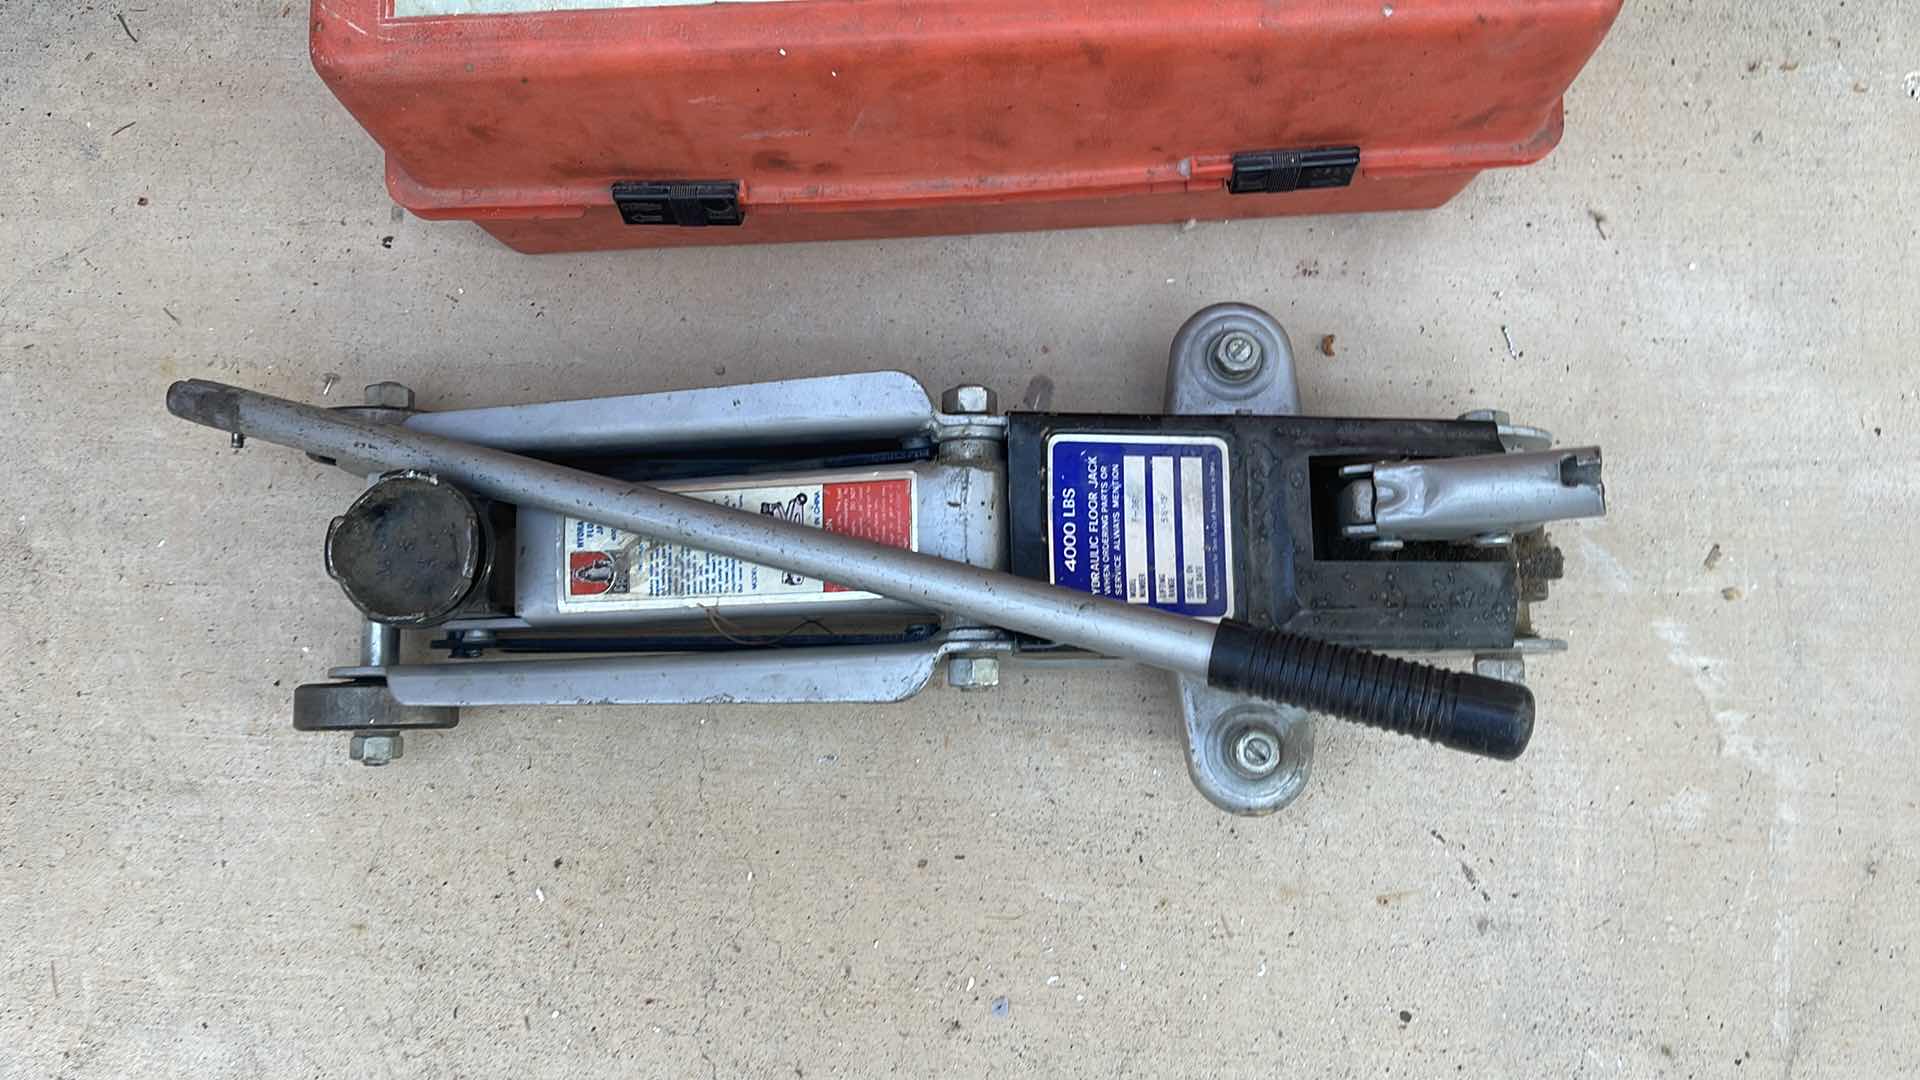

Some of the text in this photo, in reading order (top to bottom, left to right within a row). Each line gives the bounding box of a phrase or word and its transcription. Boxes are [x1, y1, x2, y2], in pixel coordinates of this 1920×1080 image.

[1100, 465, 1108, 479] OR
[576, 520, 584, 548] HYDRA
[1063, 488, 1077, 572] 4000 LBS
[1087, 456, 1101, 595] YDRAULIC FLOOR JACK
[1101, 515, 1110, 562] ORDERING
[1111, 464, 1123, 595] SERVICE ALWAYS MENTION
[1102, 564, 1111, 595] WHEN
